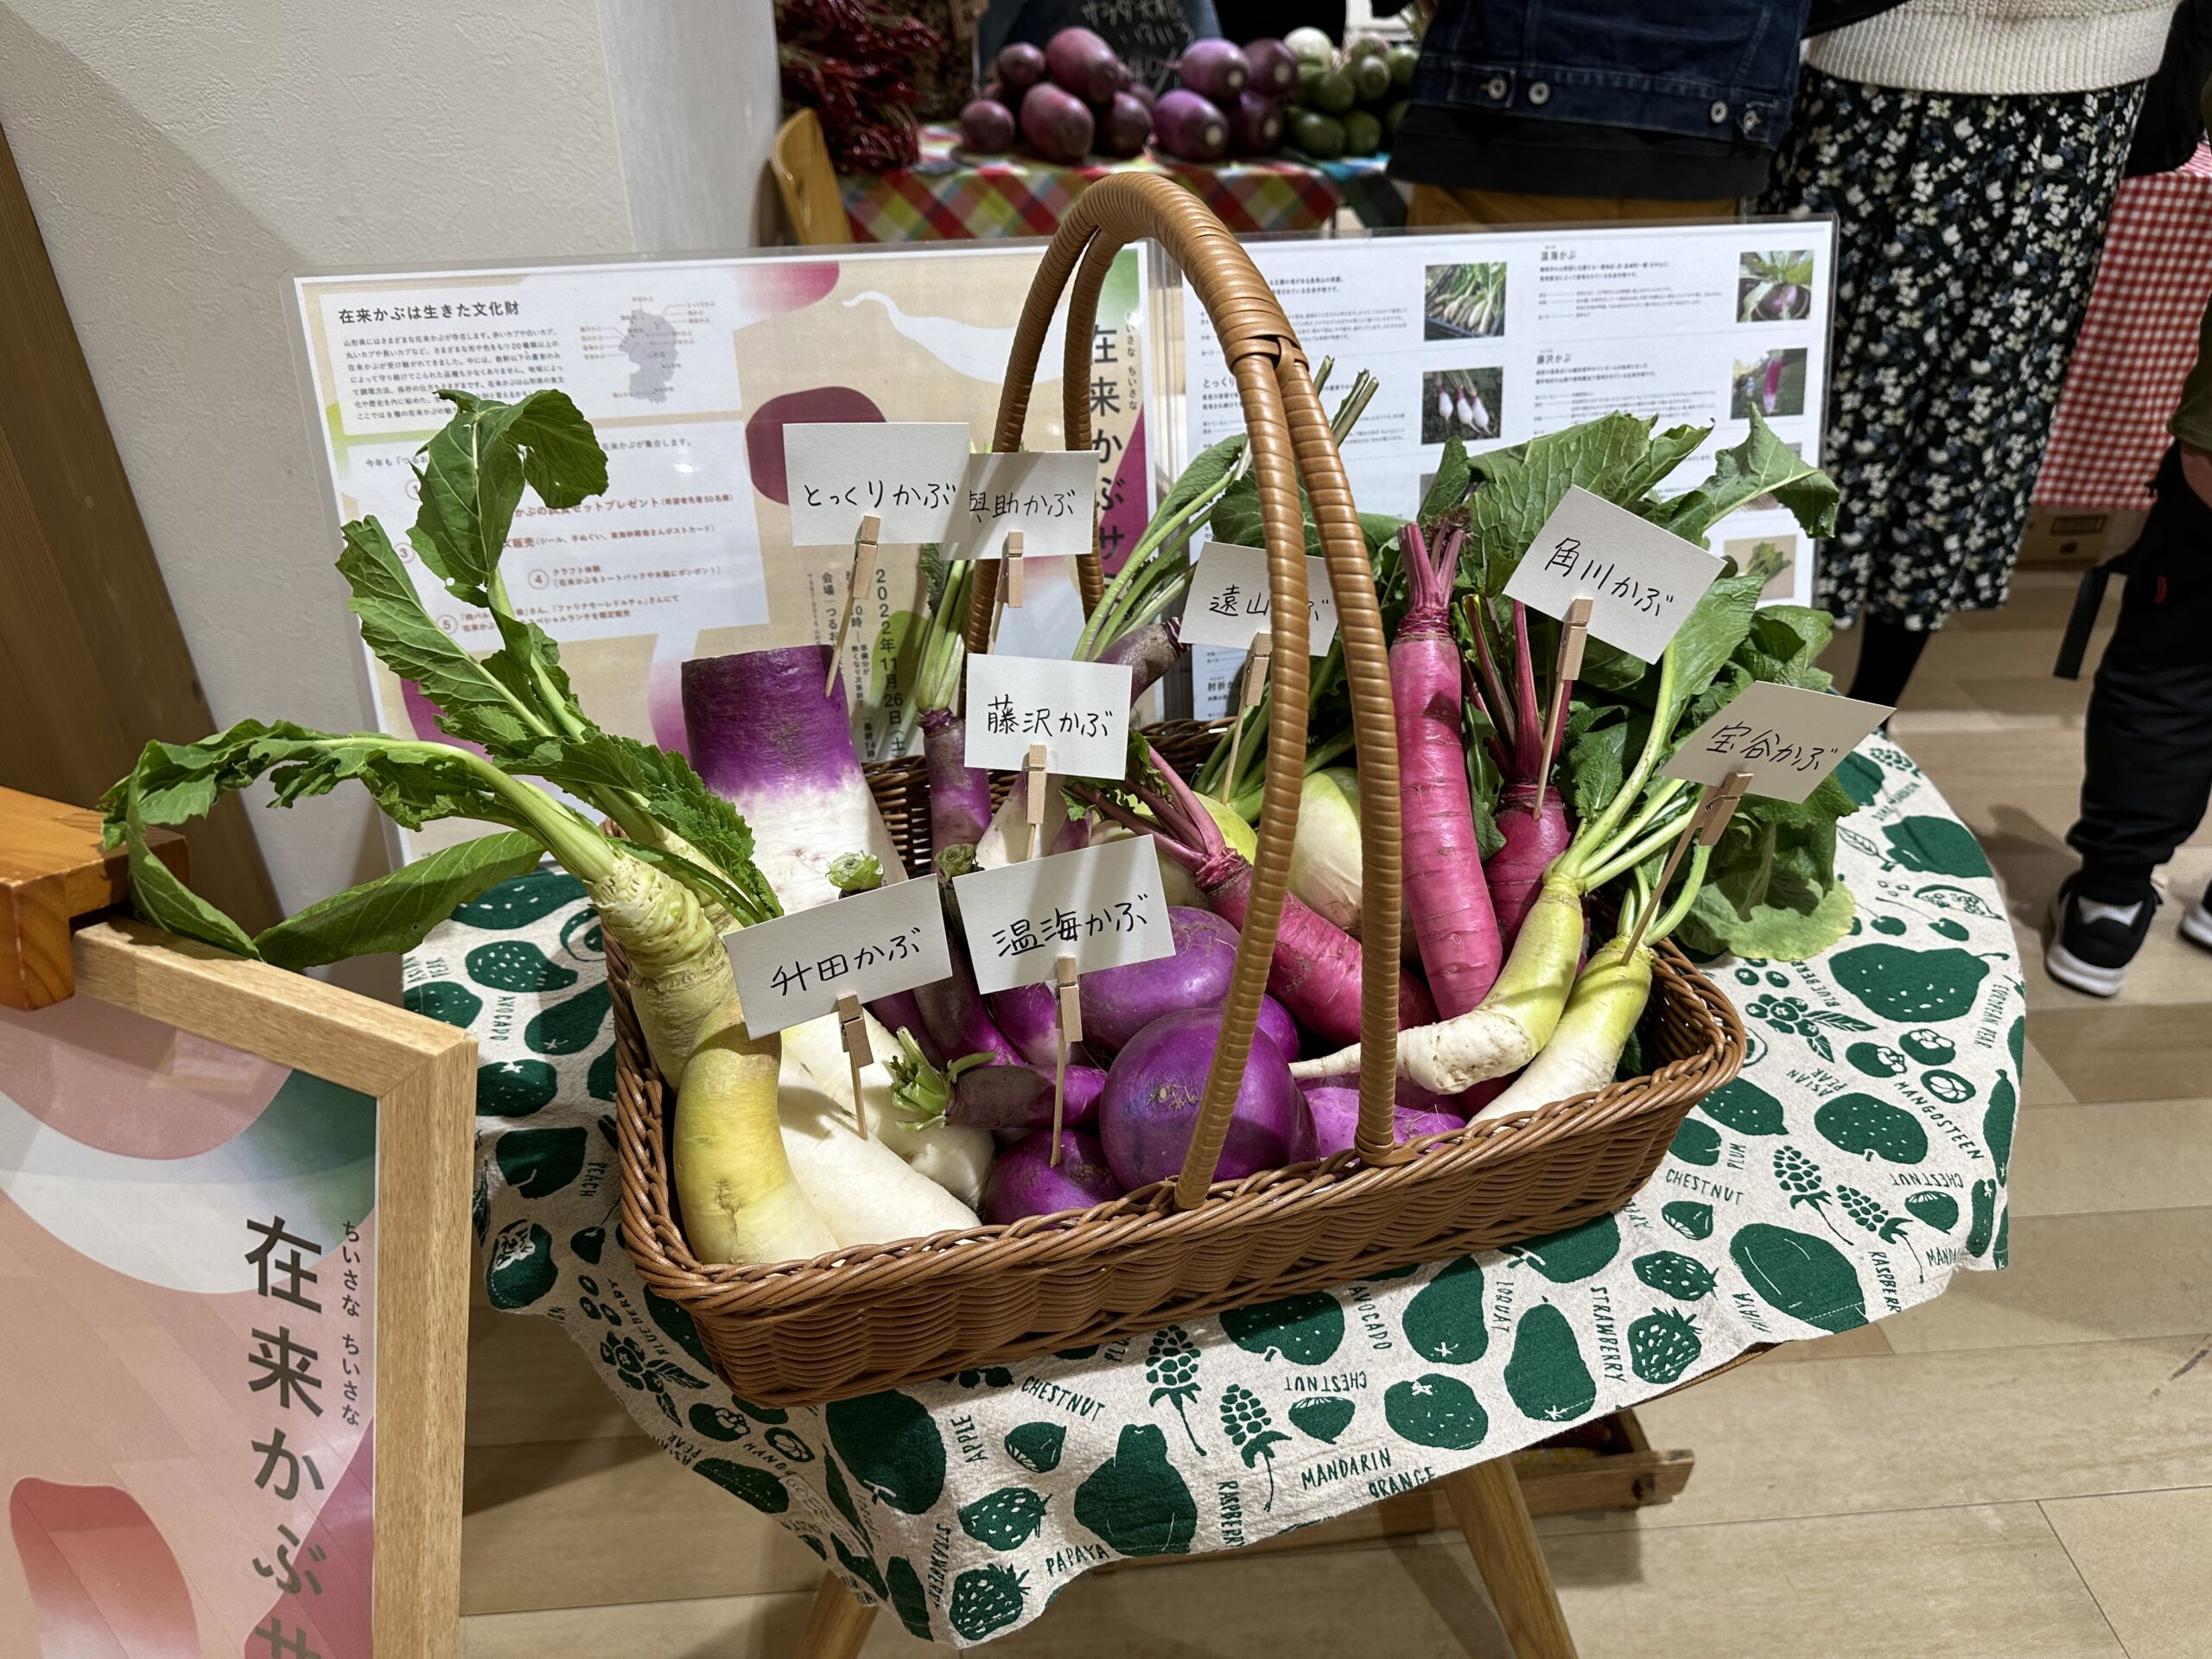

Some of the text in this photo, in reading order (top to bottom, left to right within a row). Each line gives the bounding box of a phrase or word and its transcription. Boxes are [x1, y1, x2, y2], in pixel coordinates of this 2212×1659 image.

[338, 301, 520, 325] 在来かぶは生きた文化財
[1090, 325, 1126, 586] 在来かぶサ
[803, 480, 957, 508] とっくりかぶ
[1544, 537, 1675, 617] 角川かぶ
[1209, 583, 1329, 621] 遠山ぶ
[986, 694, 1113, 737] 藤沢かぶ
[1705, 720, 1839, 772] 宝谷かぶ
[991, 893, 1150, 958] 温海かぶ
[770, 926, 922, 996] 升田かぶ
[489, 995, 517, 1041] AVOCADO
[1786, 1068, 1834, 1097] ASIAN
[1810, 1067, 1848, 1092] PEAR
[1893, 1080, 1985, 1160] MANGOSTEEN
[1726, 1142, 1746, 1170] PLUM
[579, 1162, 608, 1197] PEACH
[1665, 1168, 1745, 1206] CHESTNUT
[1890, 1173, 1965, 1189] CHESTNUT
[341, 1220, 361, 1427] ちいさな ちいさな
[607, 1278, 670, 1356] BLUEBERRY
[1348, 1286, 1393, 1351] AVOCADO
[1491, 1281, 1515, 1333] LOQUAT
[1590, 1286, 1627, 1383] STRAWBERRY
[1021, 1375, 1106, 1422] CHESTNUT
[1284, 1370, 1368, 1393] CHESTNUT
[951, 1414, 988, 1464] APPLE
[1300, 1447, 1393, 1491] MANDARIN
[1045, 1543, 1110, 1573] PAPAYA
